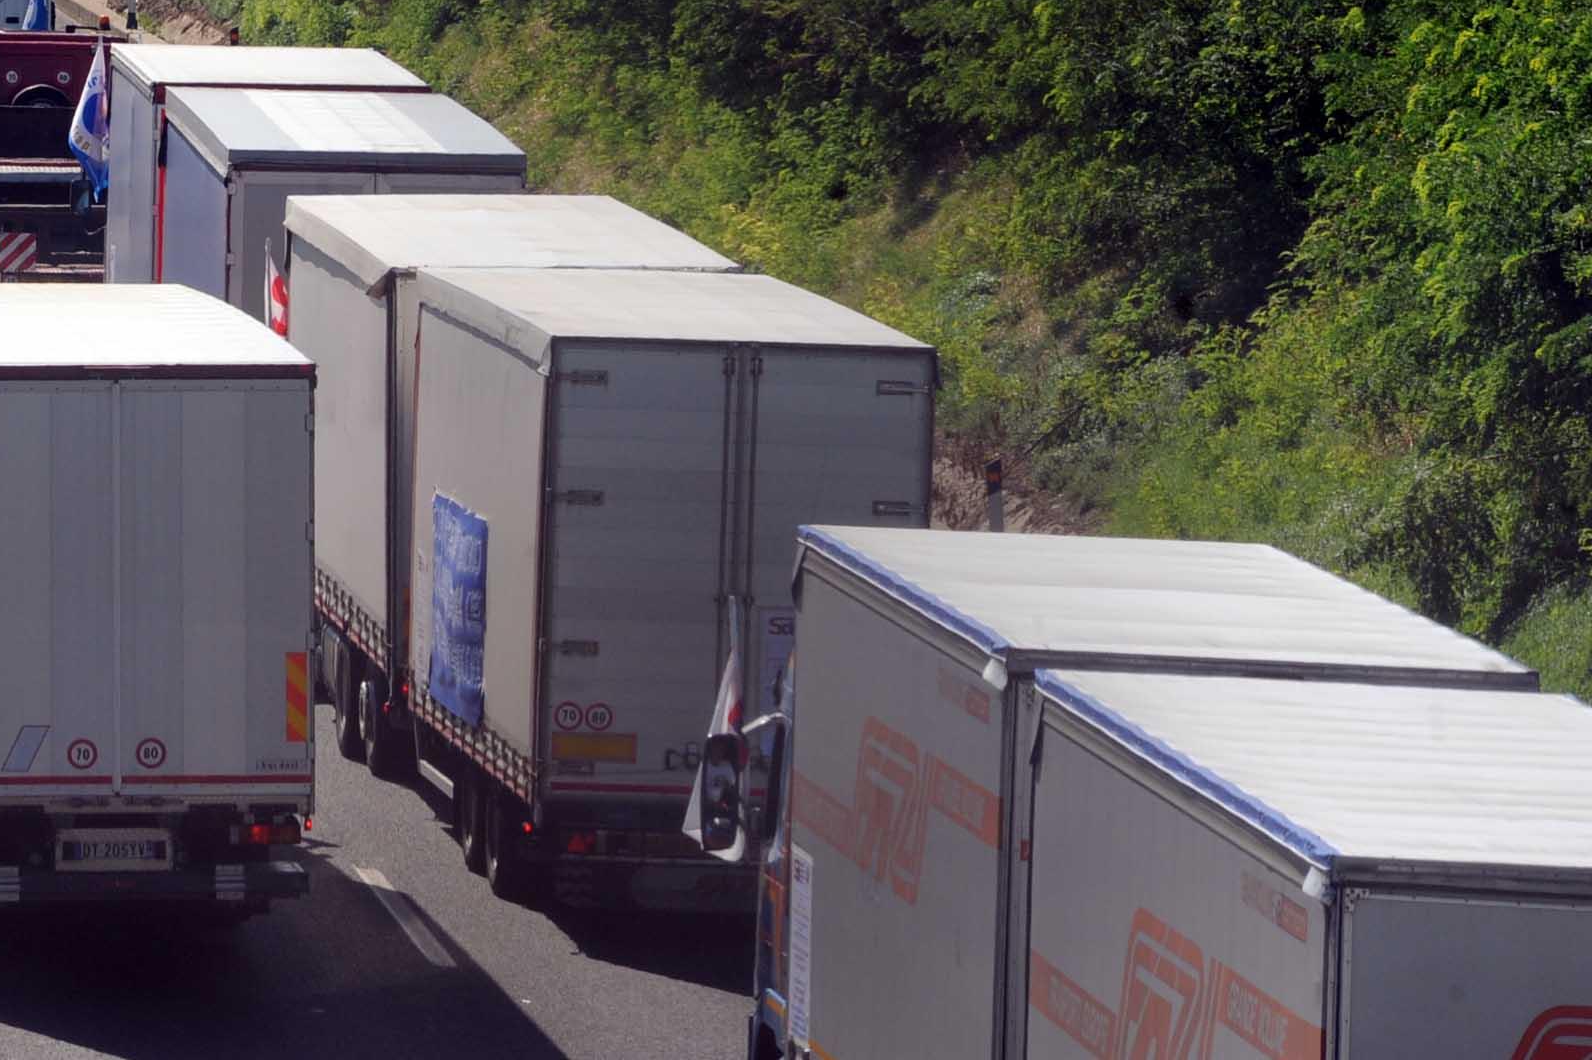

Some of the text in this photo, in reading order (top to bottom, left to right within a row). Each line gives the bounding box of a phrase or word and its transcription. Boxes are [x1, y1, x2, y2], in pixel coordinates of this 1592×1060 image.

[561, 709, 576, 721] 70
[76, 747, 91, 761] 70
[143, 747, 159, 760] 80
